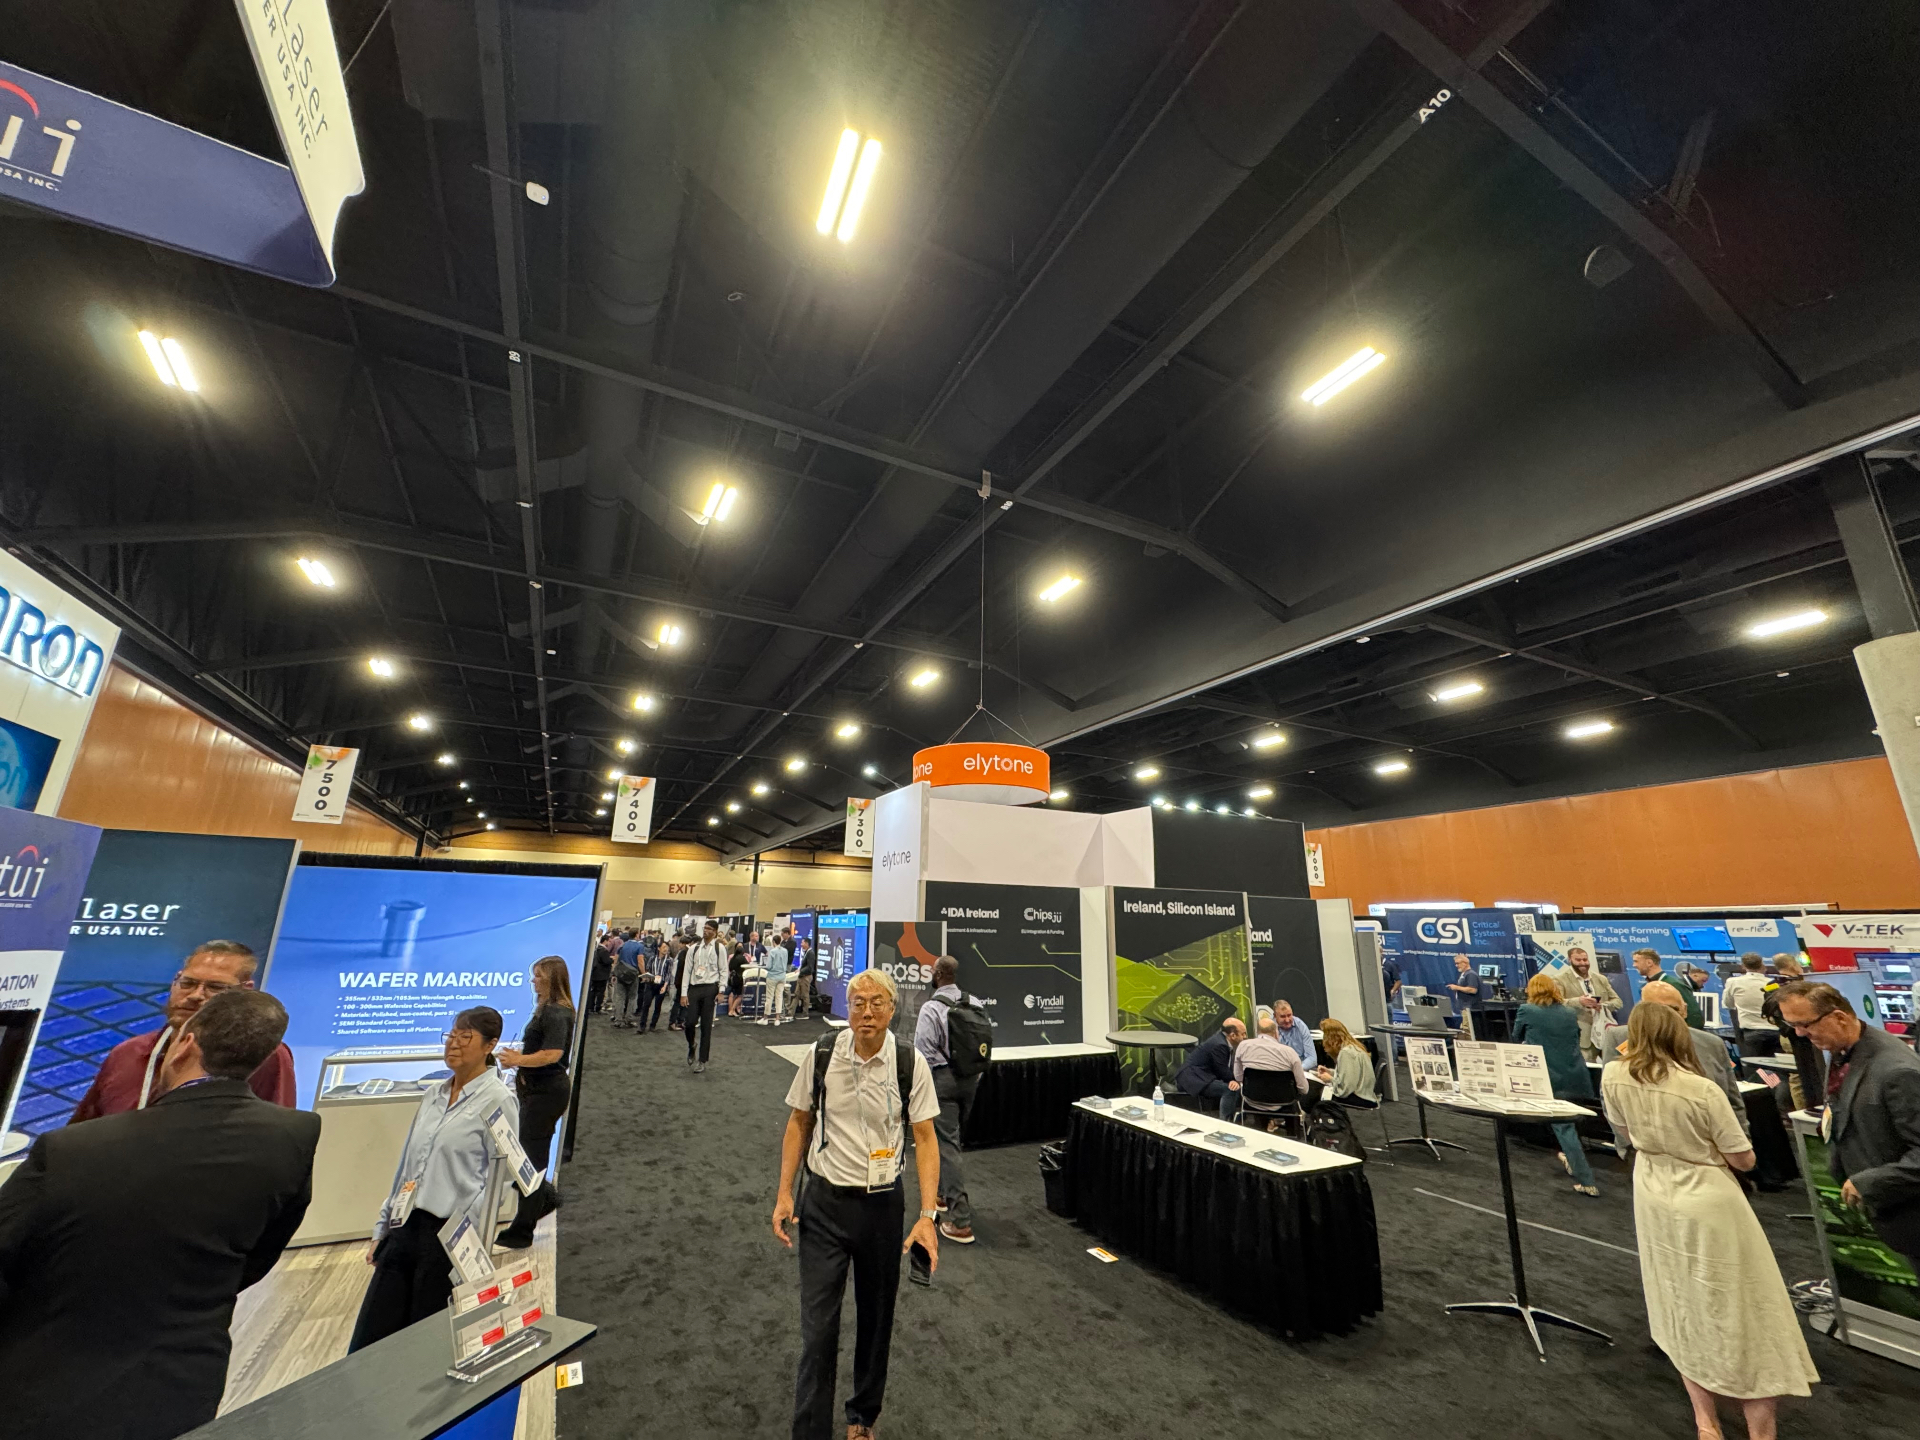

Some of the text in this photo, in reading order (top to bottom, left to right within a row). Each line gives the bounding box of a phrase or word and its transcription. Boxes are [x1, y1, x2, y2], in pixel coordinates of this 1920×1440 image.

[277, 42, 295, 101] USA
[1418, 88, 1452, 124] A10
[28, 175, 60, 192] INC.
[913, 761, 933, 780] one
[963, 753, 1034, 775] elytone
[314, 759, 338, 811] 7500
[626, 787, 641, 832] 7400
[855, 808, 865, 848] 7300
[882, 850, 912, 872] elytone
[668, 883, 696, 895] EXIT
[82, 898, 180, 920] laser
[948, 907, 1000, 919] IDA Ireland
[1024, 907, 1052, 922] Chips
[1123, 900, 1236, 916] Ireland, Silicon Island
[87, 925, 122, 936] USA
[127, 926, 165, 936] INC.
[1416, 917, 1472, 946] CSI
[1472, 921, 1500, 929] Critical
[1608, 927, 1630, 935] Tape
[1631, 927, 1670, 936] Forming
[1732, 926, 1773, 934] re-flex
[1842, 924, 1905, 936] V-TEK
[1473, 930, 1507, 938] Systems
[1598, 935, 1619, 943] Tape
[1629, 935, 1650, 943] Reel
[339, 972, 524, 988] WAFER MARKING
[881, 962, 933, 984] ROSS
[1036, 995, 1064, 1009] Tyndall
